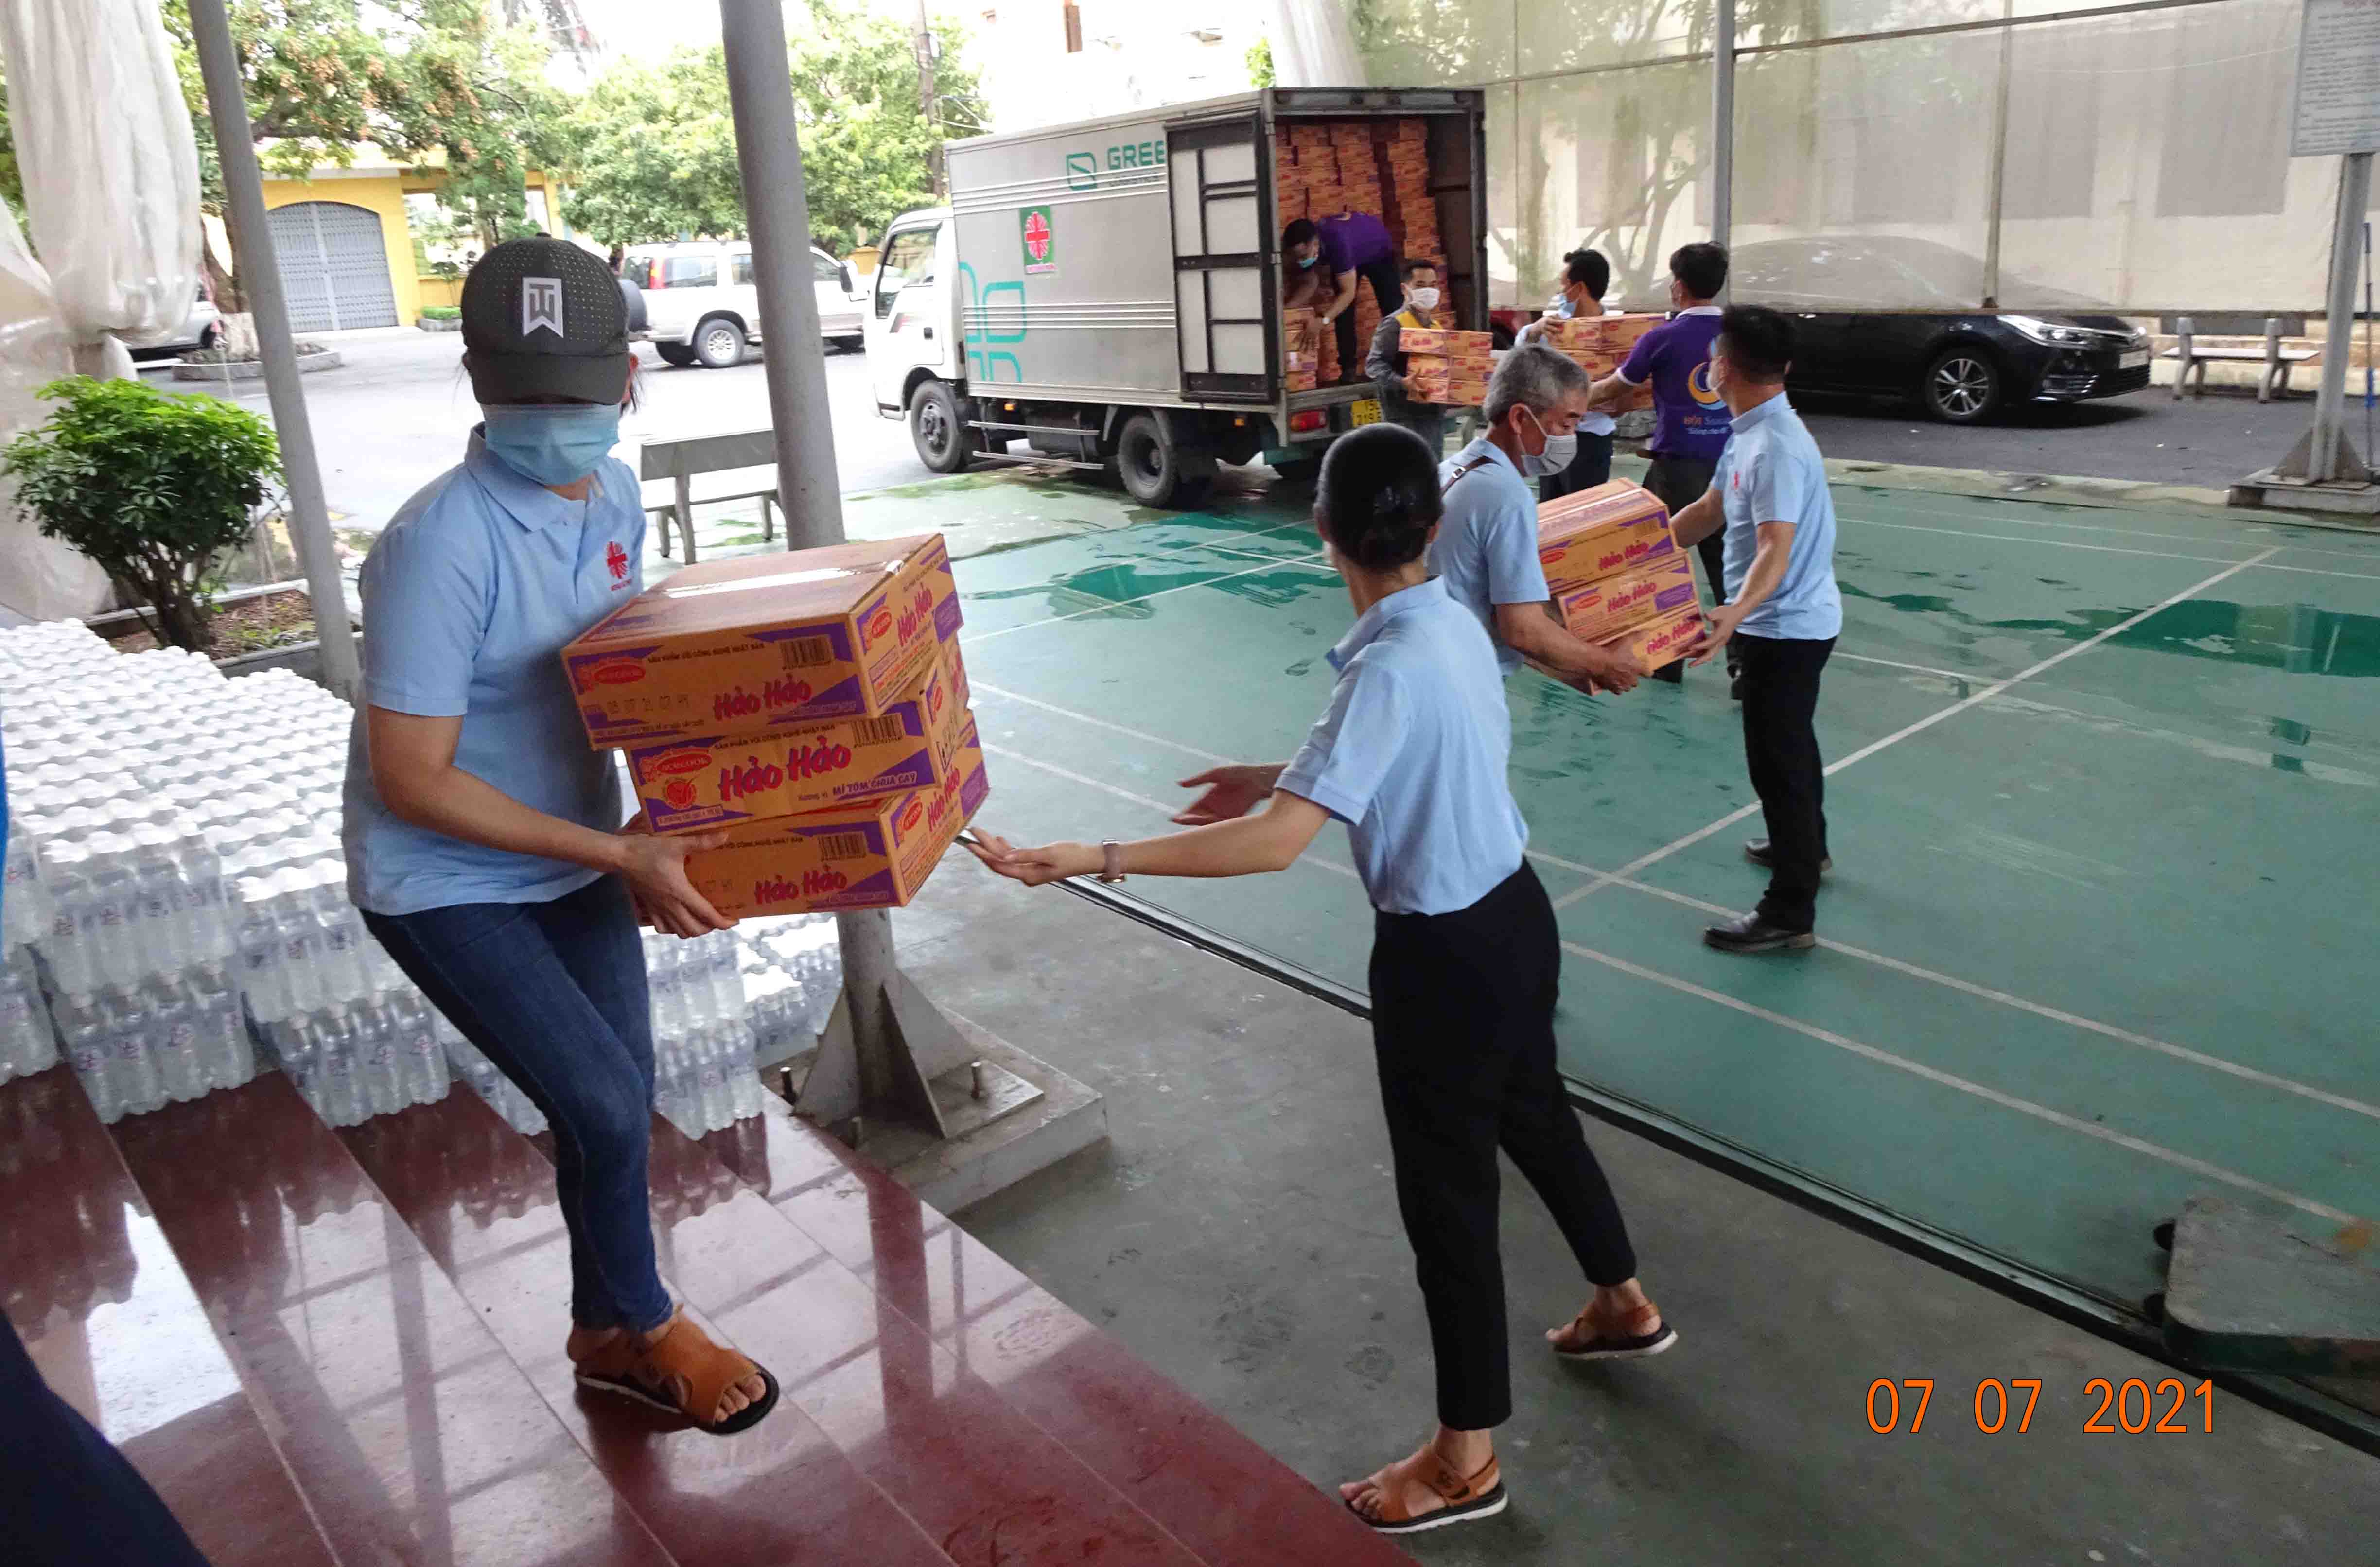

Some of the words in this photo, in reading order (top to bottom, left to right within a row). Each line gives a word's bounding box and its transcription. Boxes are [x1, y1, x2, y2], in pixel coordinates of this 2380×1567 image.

[713, 685, 761, 722] Hảo
[762, 673, 812, 709] Hảo
[718, 755, 784, 802] Hảo
[786, 734, 852, 782] Hảo
[898, 772, 916, 784] CAY
[754, 875, 800, 905] Hảo
[802, 864, 848, 895] Hảo
